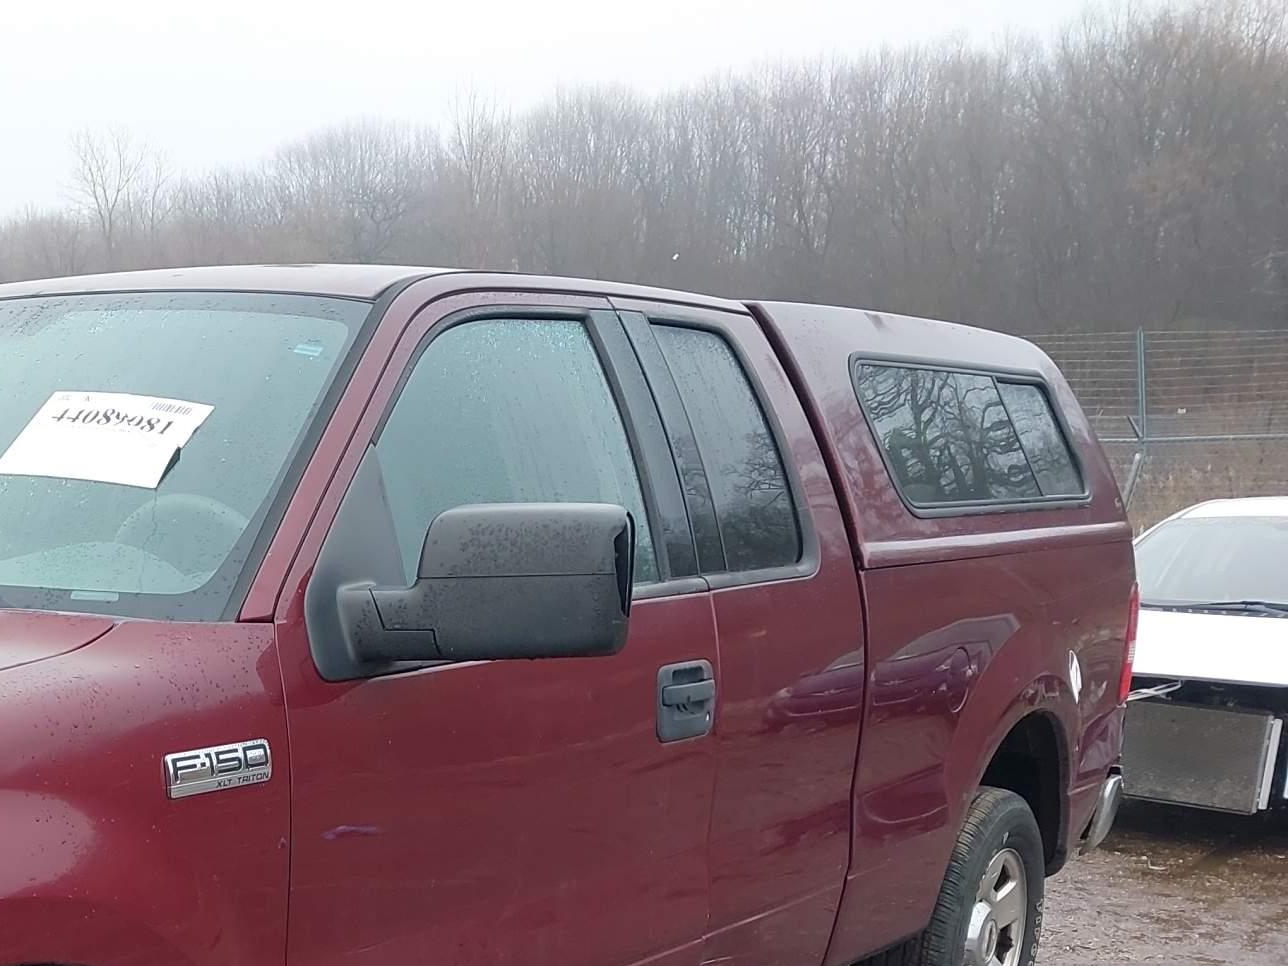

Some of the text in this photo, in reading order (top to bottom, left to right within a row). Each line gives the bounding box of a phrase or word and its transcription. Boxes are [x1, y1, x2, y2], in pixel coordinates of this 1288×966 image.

[52, 408, 174, 435] 44089081
[171, 743, 269, 783] F-150
[216, 771, 269, 789] XLT TRITON
